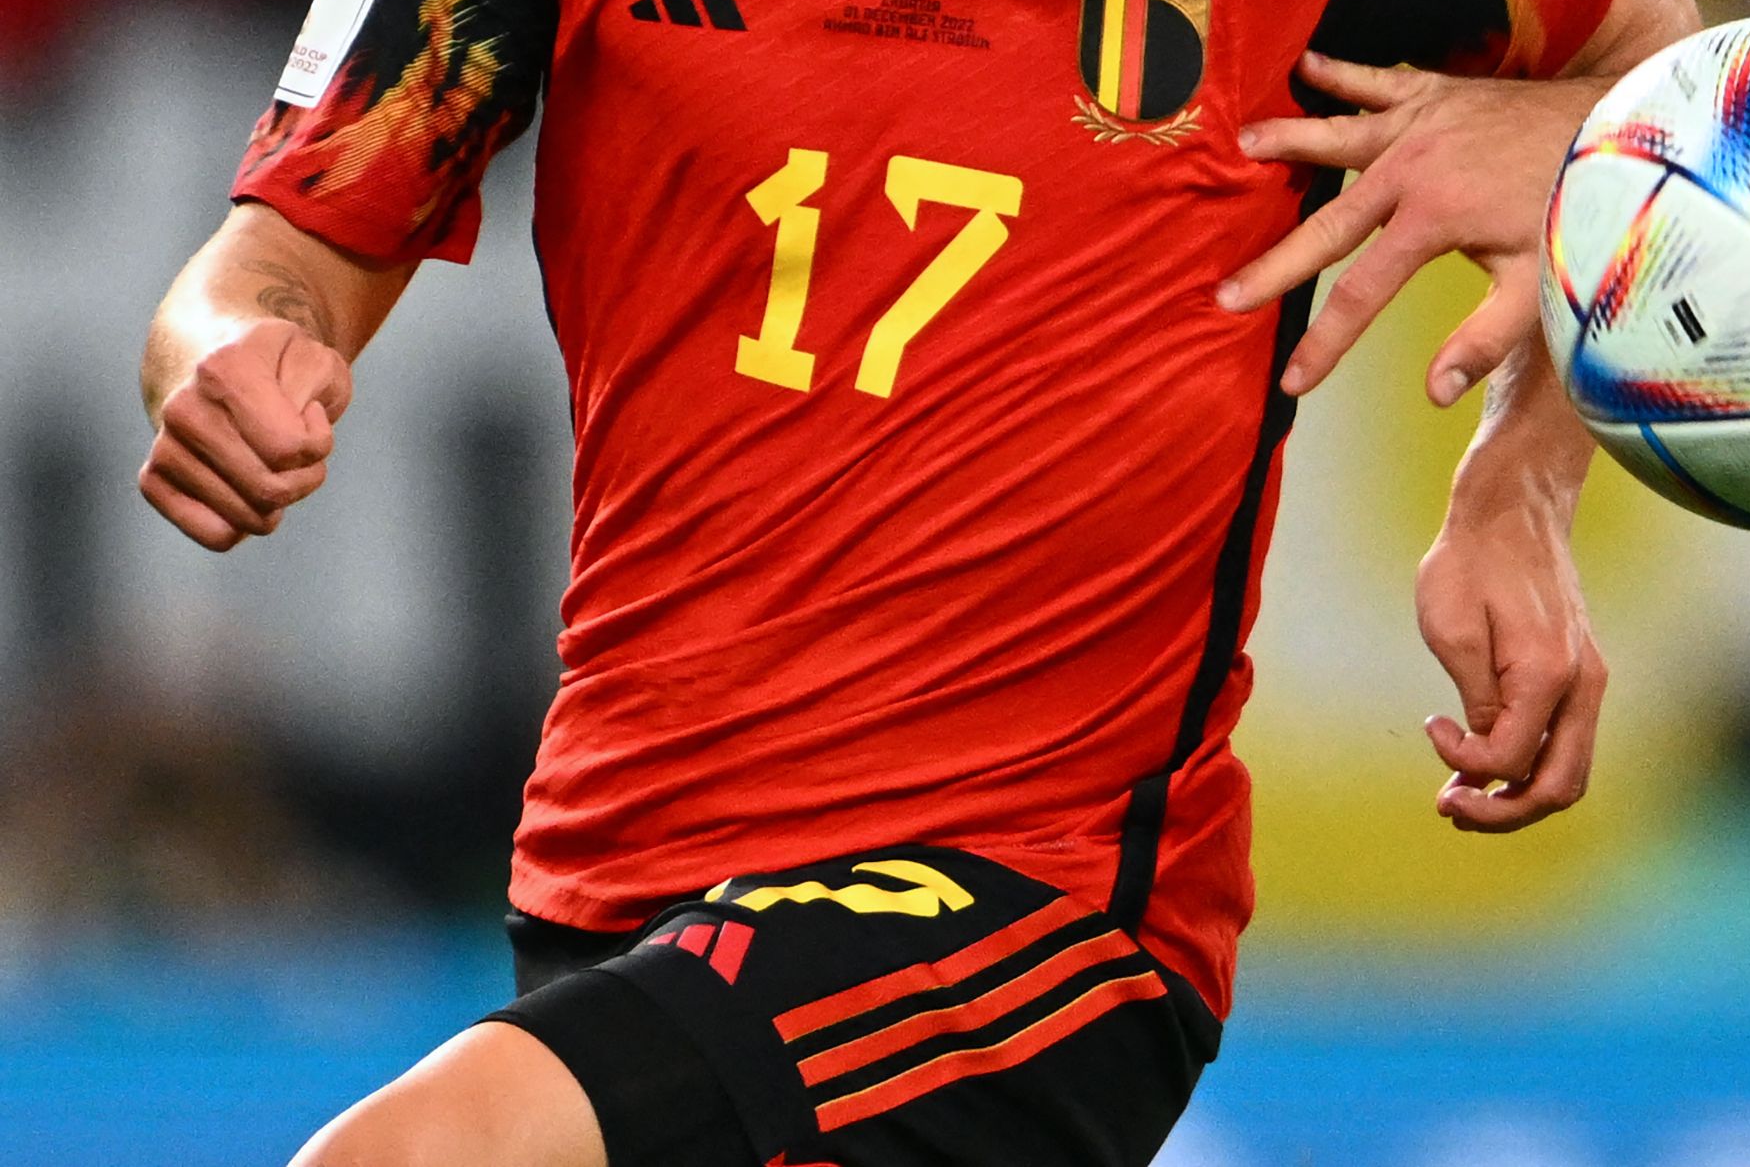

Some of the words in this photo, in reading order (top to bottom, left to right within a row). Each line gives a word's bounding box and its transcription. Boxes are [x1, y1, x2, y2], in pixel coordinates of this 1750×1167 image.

[940, 15, 975, 32] 2022
[308, 49, 328, 62] CUP
[734, 147, 1024, 399] 17
